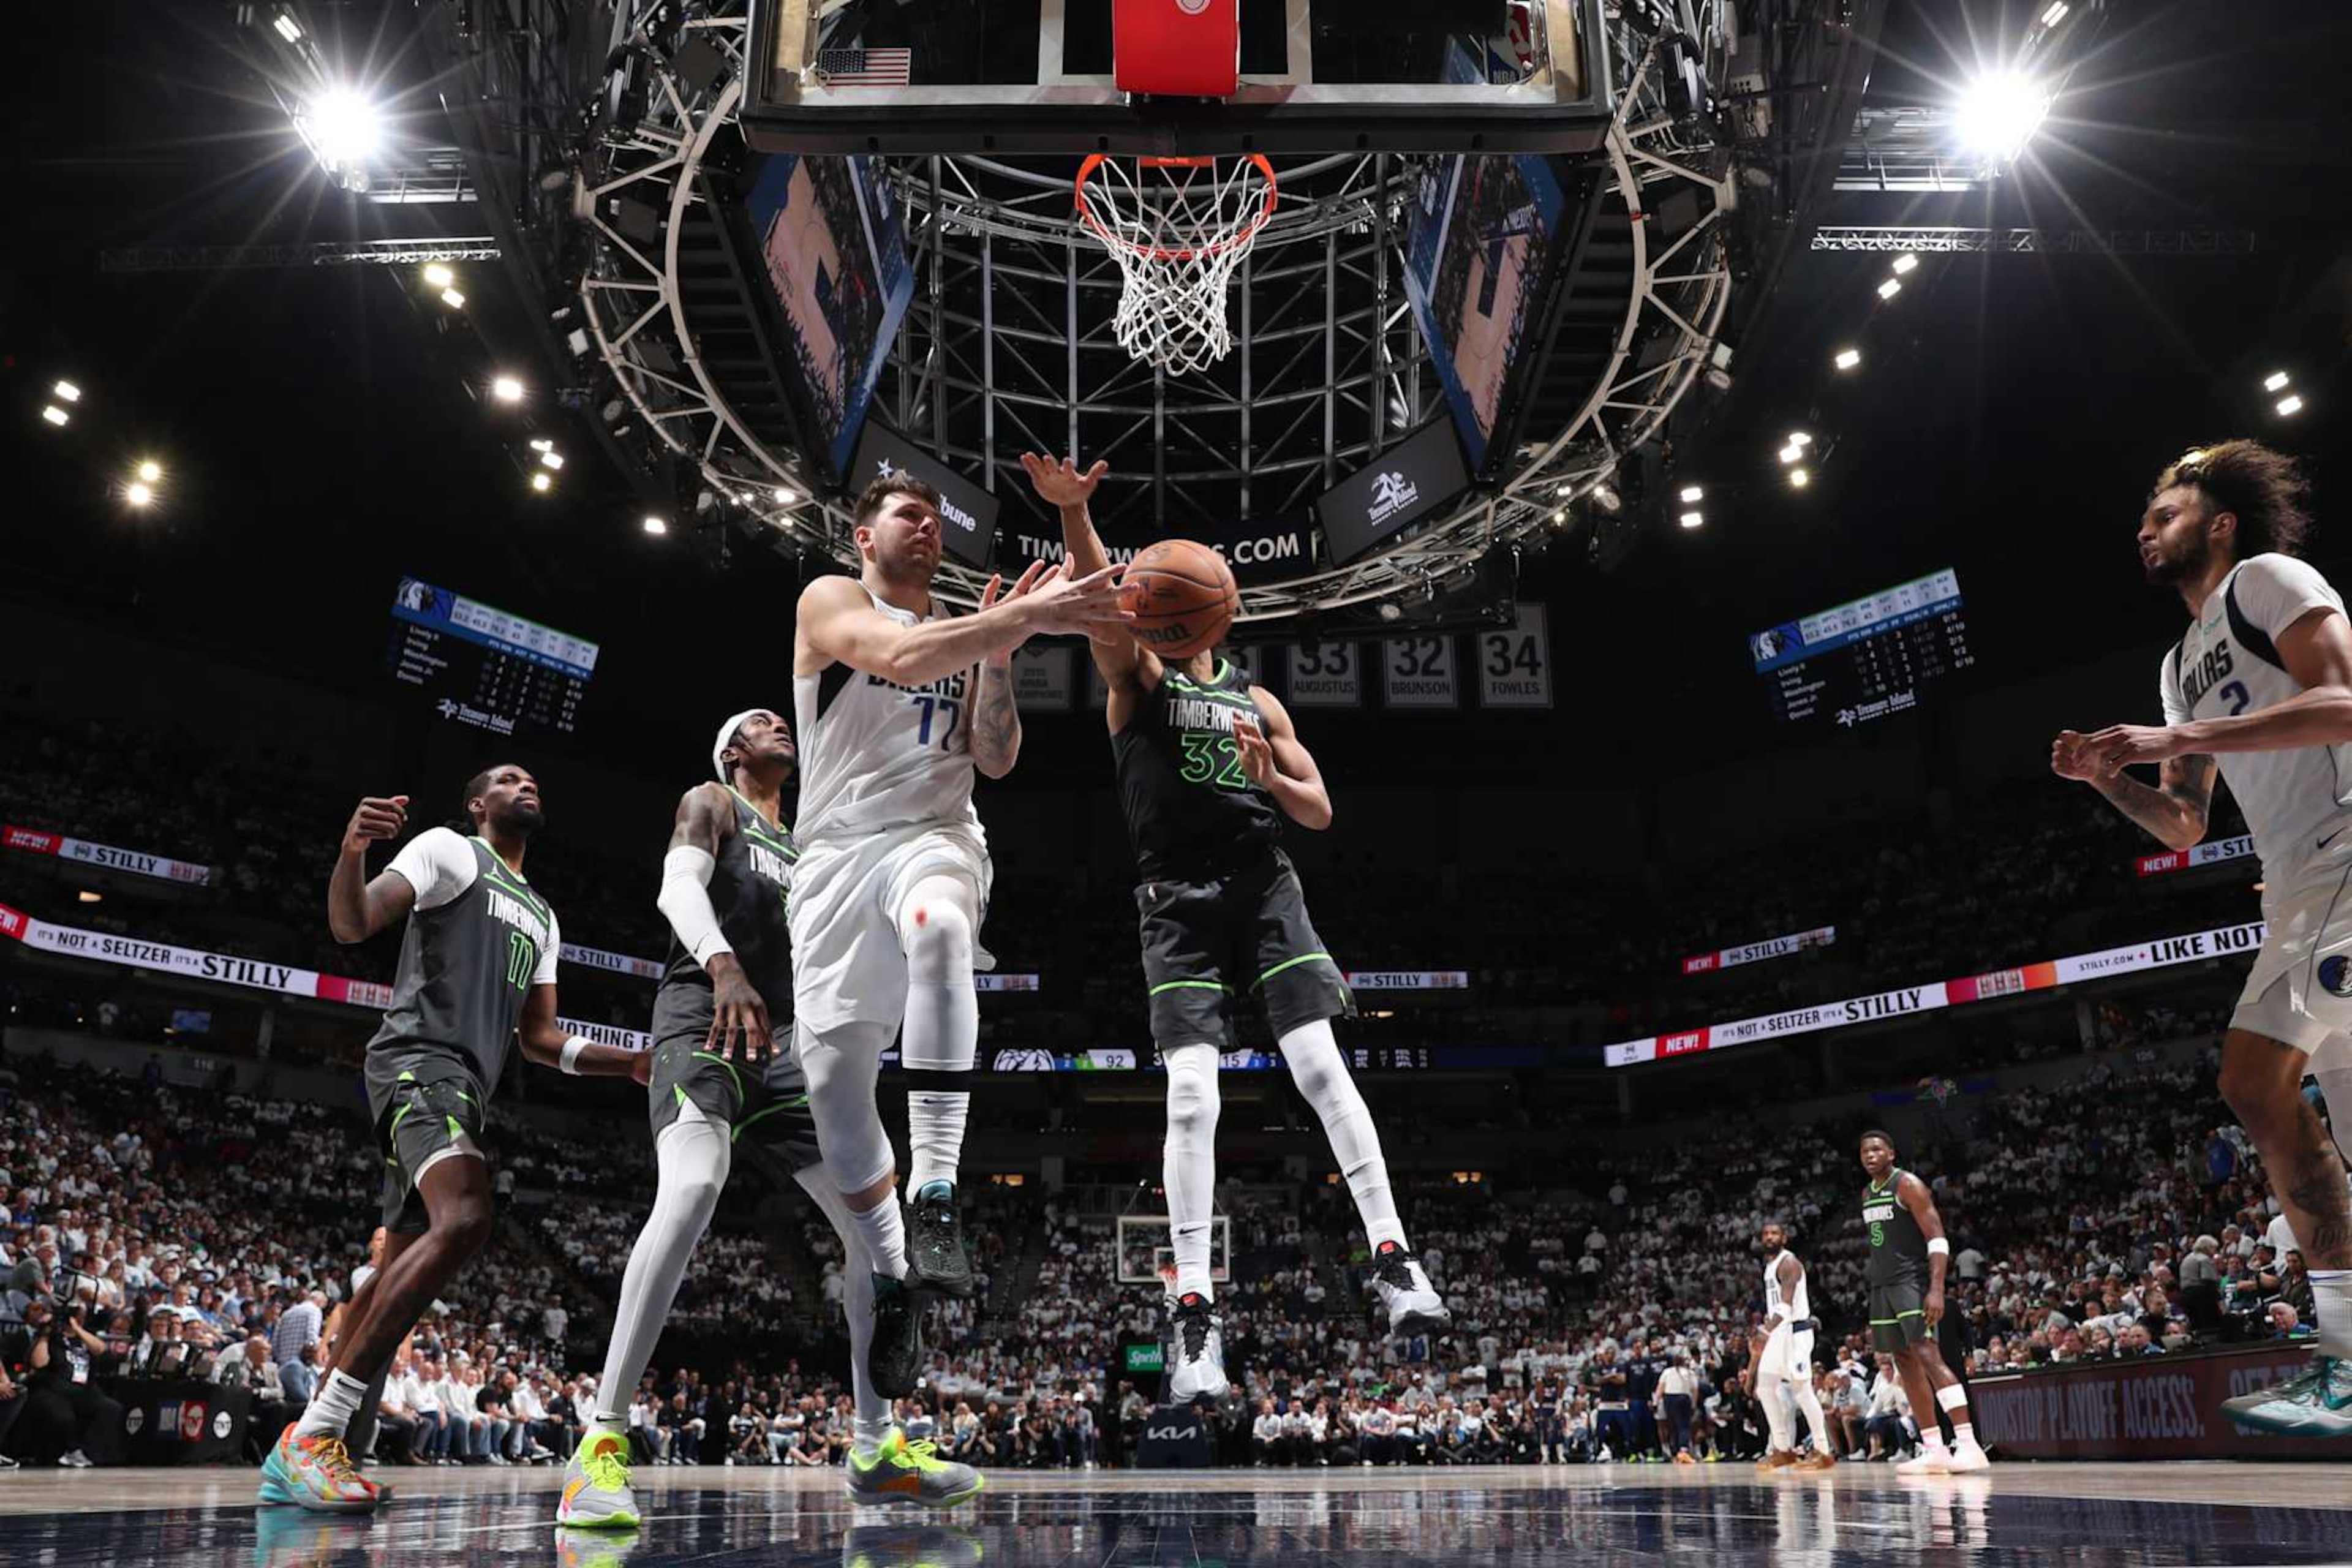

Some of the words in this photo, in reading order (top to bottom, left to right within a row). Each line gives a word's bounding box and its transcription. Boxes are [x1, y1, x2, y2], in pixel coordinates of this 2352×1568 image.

[940, 494, 976, 532] bune
[1395, 637, 1444, 676] 32
[1487, 635, 1542, 676] 34
[1294, 679, 1355, 693] AUGUSTUS
[1390, 681, 1450, 695] BRUNSON
[1492, 681, 1539, 695] FOWLES
[2220, 680, 2250, 717] 2
[912, 696, 960, 753] 77
[1180, 733, 1246, 790] 32
[96, 847, 158, 873] STILLY
[2143, 854, 2177, 872] NEW!
[58, 932, 88, 949] NOT
[91, 941, 98, 949] A
[101, 938, 172, 965] SELTZER
[192, 958, 200, 967] A
[202, 955, 292, 989] STILLY
[578, 949, 624, 969] STILLY
[1744, 939, 1789, 960] STILLY
[2079, 955, 2134, 971] STILLY.COM
[2150, 935, 2206, 963] LIKE
[1374, 973, 1423, 987] STILLY
[1665, 1033, 1700, 1054] NEW!
[1736, 1023, 1758, 1036] NOT
[1768, 1010, 1820, 1031] SELTZER
[1845, 989, 1922, 1021] STILLY
[1106, 1055, 1124, 1068] 92
[1870, 1221, 1885, 1247] 5
[1976, 1385, 2043, 1444] NONSTOP
[2046, 1379, 2118, 1441] PLAYOFF
[2122, 1373, 2205, 1439] ACCESS.
